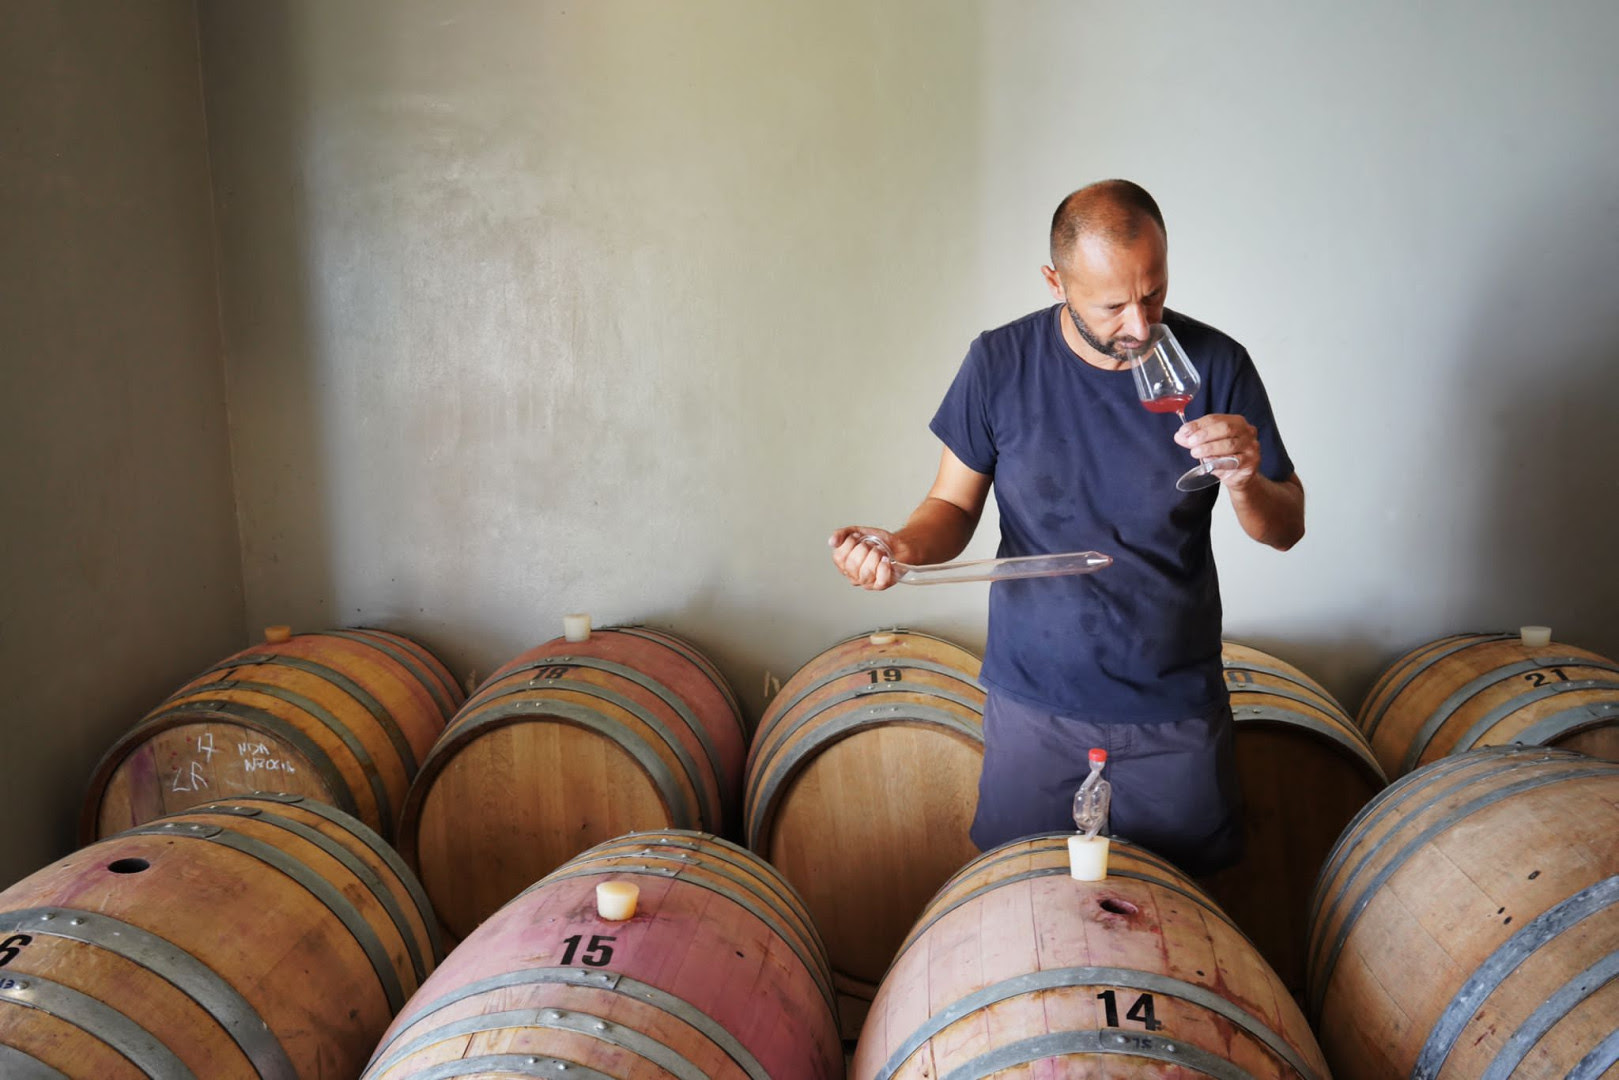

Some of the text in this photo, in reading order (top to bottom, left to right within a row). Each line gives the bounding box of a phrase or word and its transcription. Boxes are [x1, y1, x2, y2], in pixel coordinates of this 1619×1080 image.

[867, 668, 902, 684] 19
[1524, 668, 1570, 688] 21
[560, 934, 617, 967] 15
[1096, 990, 1162, 1031] 14
